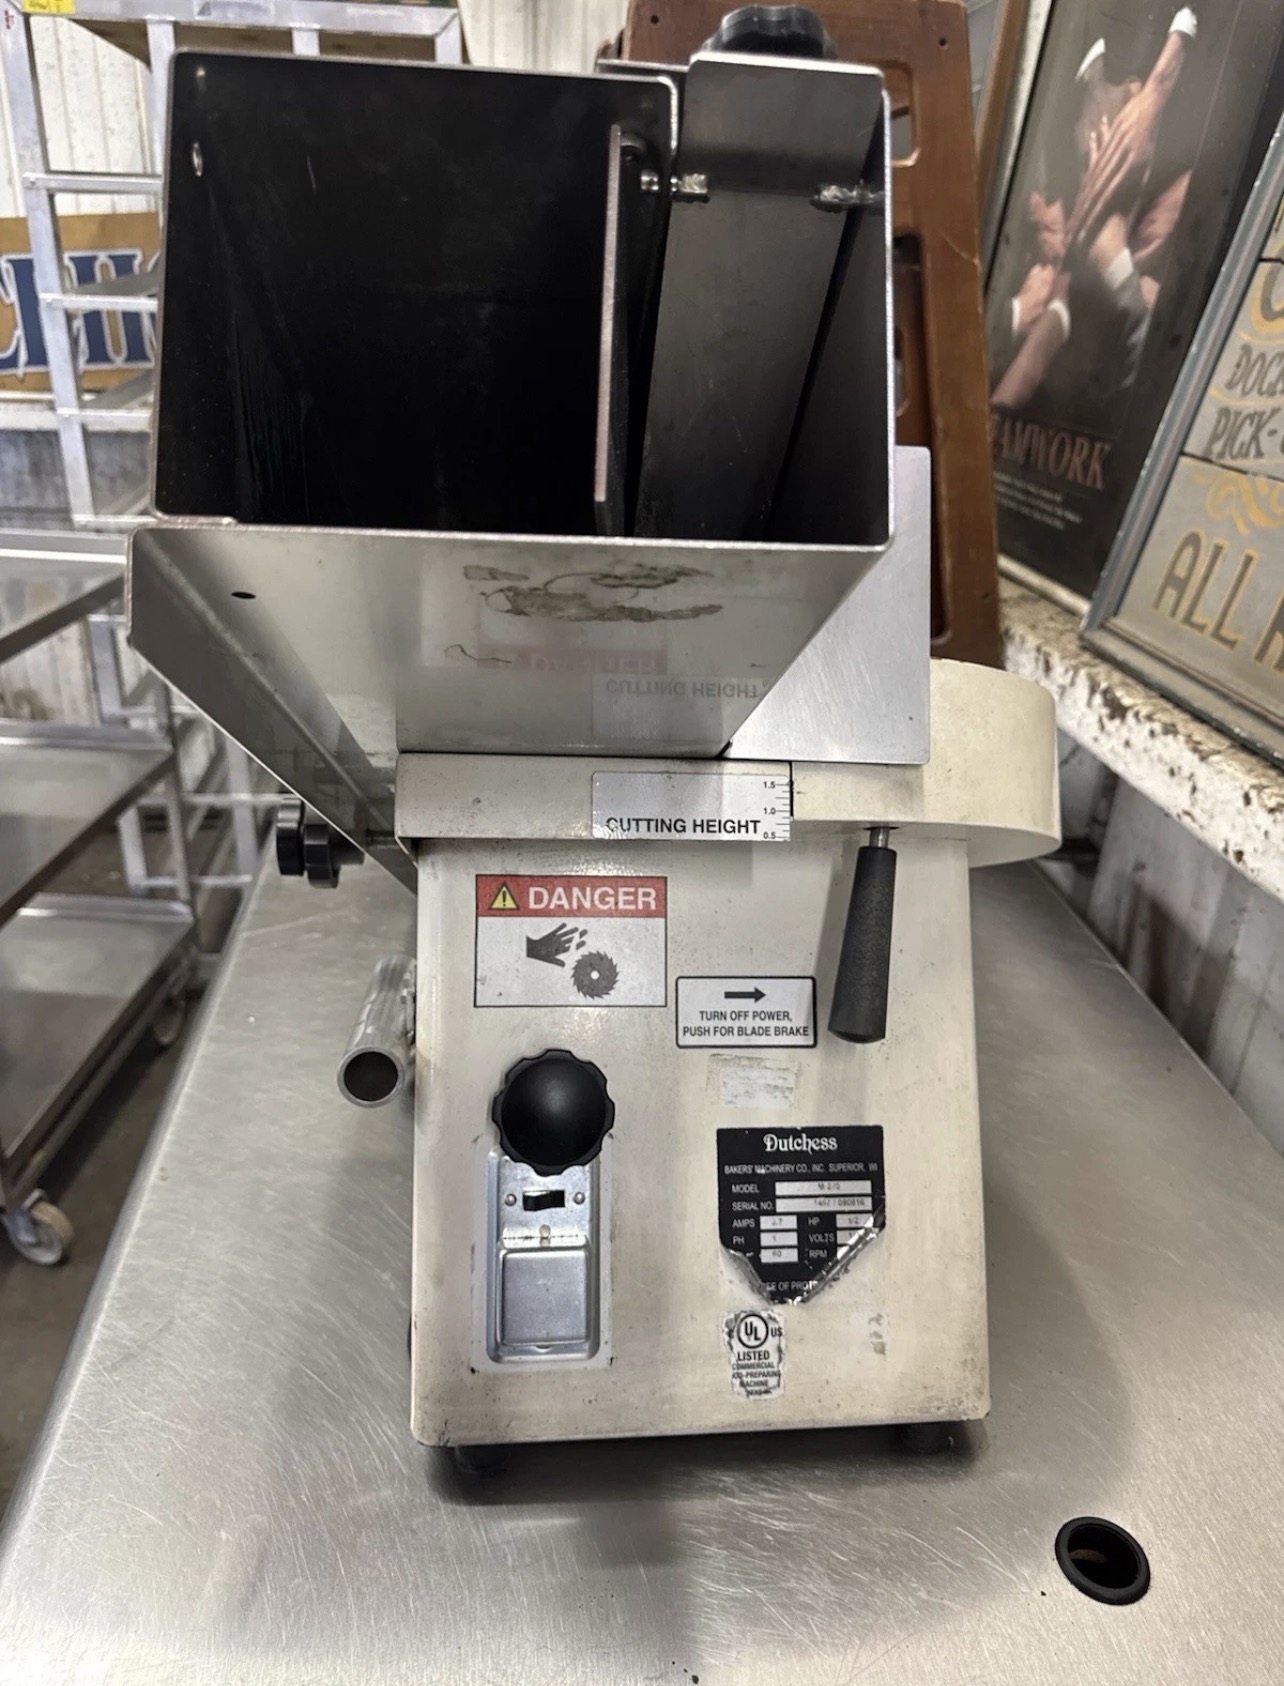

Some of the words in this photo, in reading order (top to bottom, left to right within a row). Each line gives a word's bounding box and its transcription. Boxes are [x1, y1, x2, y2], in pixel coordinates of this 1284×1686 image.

[1203, 405, 1284, 460] PICK-
[993, 416, 1111, 491] AMWORK
[1152, 530, 1255, 649] ALL
[763, 781, 776, 789] 1.5
[763, 807, 776, 815] 1.0
[606, 817, 687, 833] CUTTING
[693, 819, 761, 834] HEIGHT
[763, 832, 776, 840] 0.5
[528, 886, 657, 911] DANGER
[699, 1011, 728, 1022] TURN
[730, 1011, 750, 1021] OFF
[752, 1010, 793, 1022] POWER,
[683, 1026, 712, 1037] PUSH
[714, 1026, 735, 1037] FOR
[737, 1026, 772, 1037] BLADE
[774, 1026, 809, 1037] BRAKE
[763, 1133, 838, 1155] Dutchess
[731, 1184, 760, 1193] MODEL
[732, 1202, 759, 1211] SERIAL
[732, 1219, 755, 1228] AMPS
[808, 1217, 820, 1226] HP
[732, 1235, 745, 1244] PH
[808, 1233, 835, 1242] VOLTS
[809, 1249, 827, 1258] RPM
[778, 1281, 789, 1291] OF
[737, 1350, 770, 1361] LISTED
